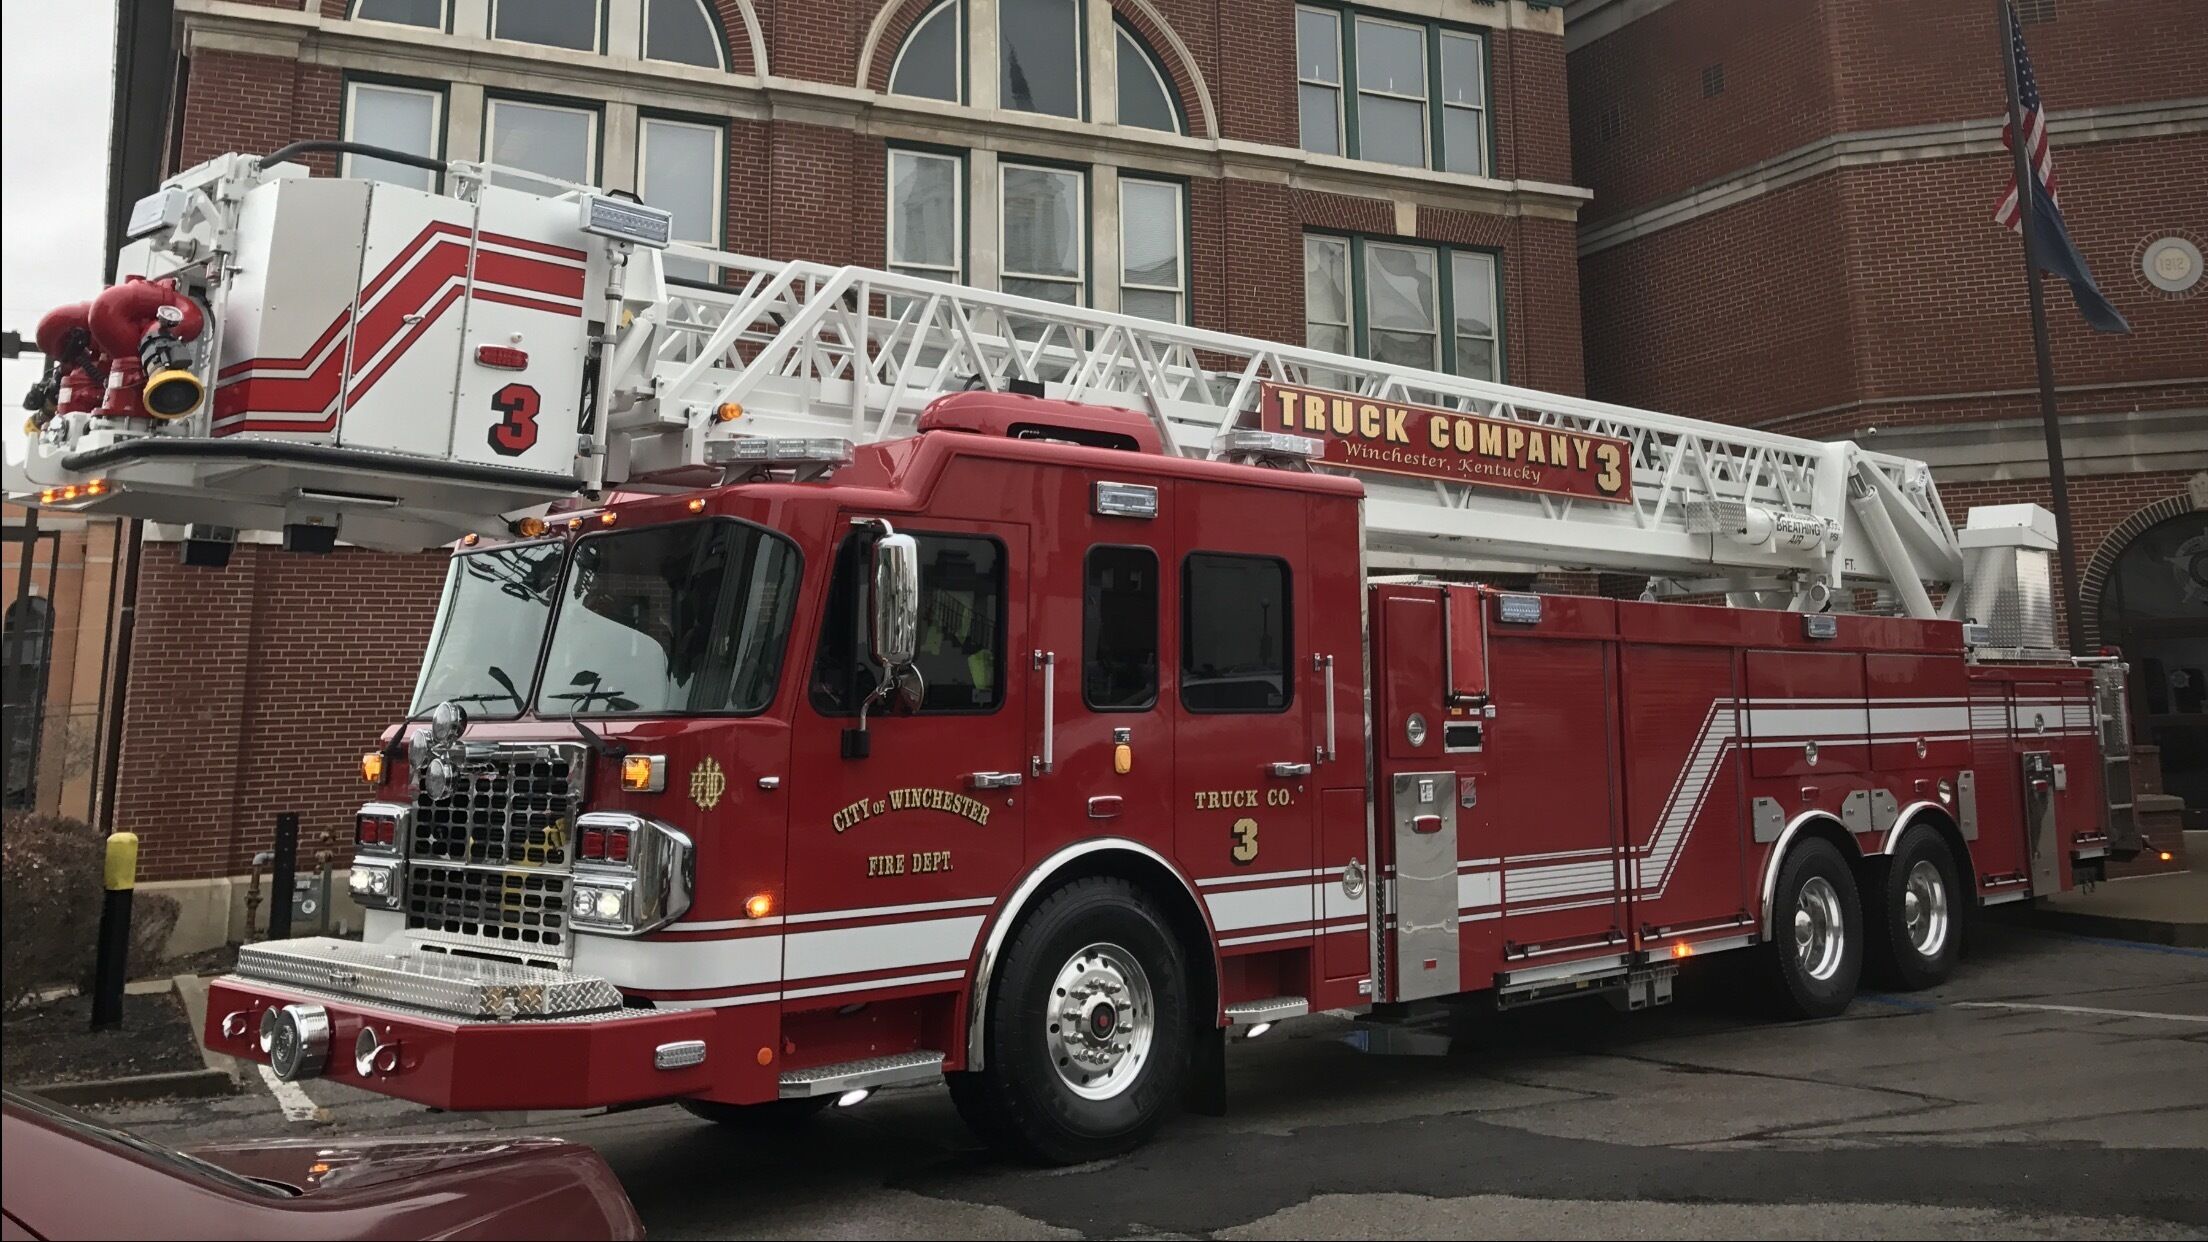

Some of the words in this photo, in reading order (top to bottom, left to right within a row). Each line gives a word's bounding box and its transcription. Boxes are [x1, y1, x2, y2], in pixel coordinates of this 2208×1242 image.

[487, 383, 541, 457] 3
[1277, 390, 1410, 443] TRUCK
[1429, 415, 1593, 471] COMPANY
[1595, 443, 1622, 494] 3
[1340, 439, 1451, 474] Winchester,
[1457, 458, 1541, 485] Kentucky
[1776, 520, 1820, 536] BREATHING
[1844, 558, 1857, 572] FT.
[832, 798, 870, 833] CITY
[872, 800, 886, 815] OF
[888, 788, 991, 827] WINCHESTER
[1194, 789, 1259, 809] TRUCK
[1267, 788, 1295, 806] CO.
[1231, 818, 1258, 863] 3
[867, 854, 905, 878] FIRE
[912, 850, 954, 873] DEPT.
